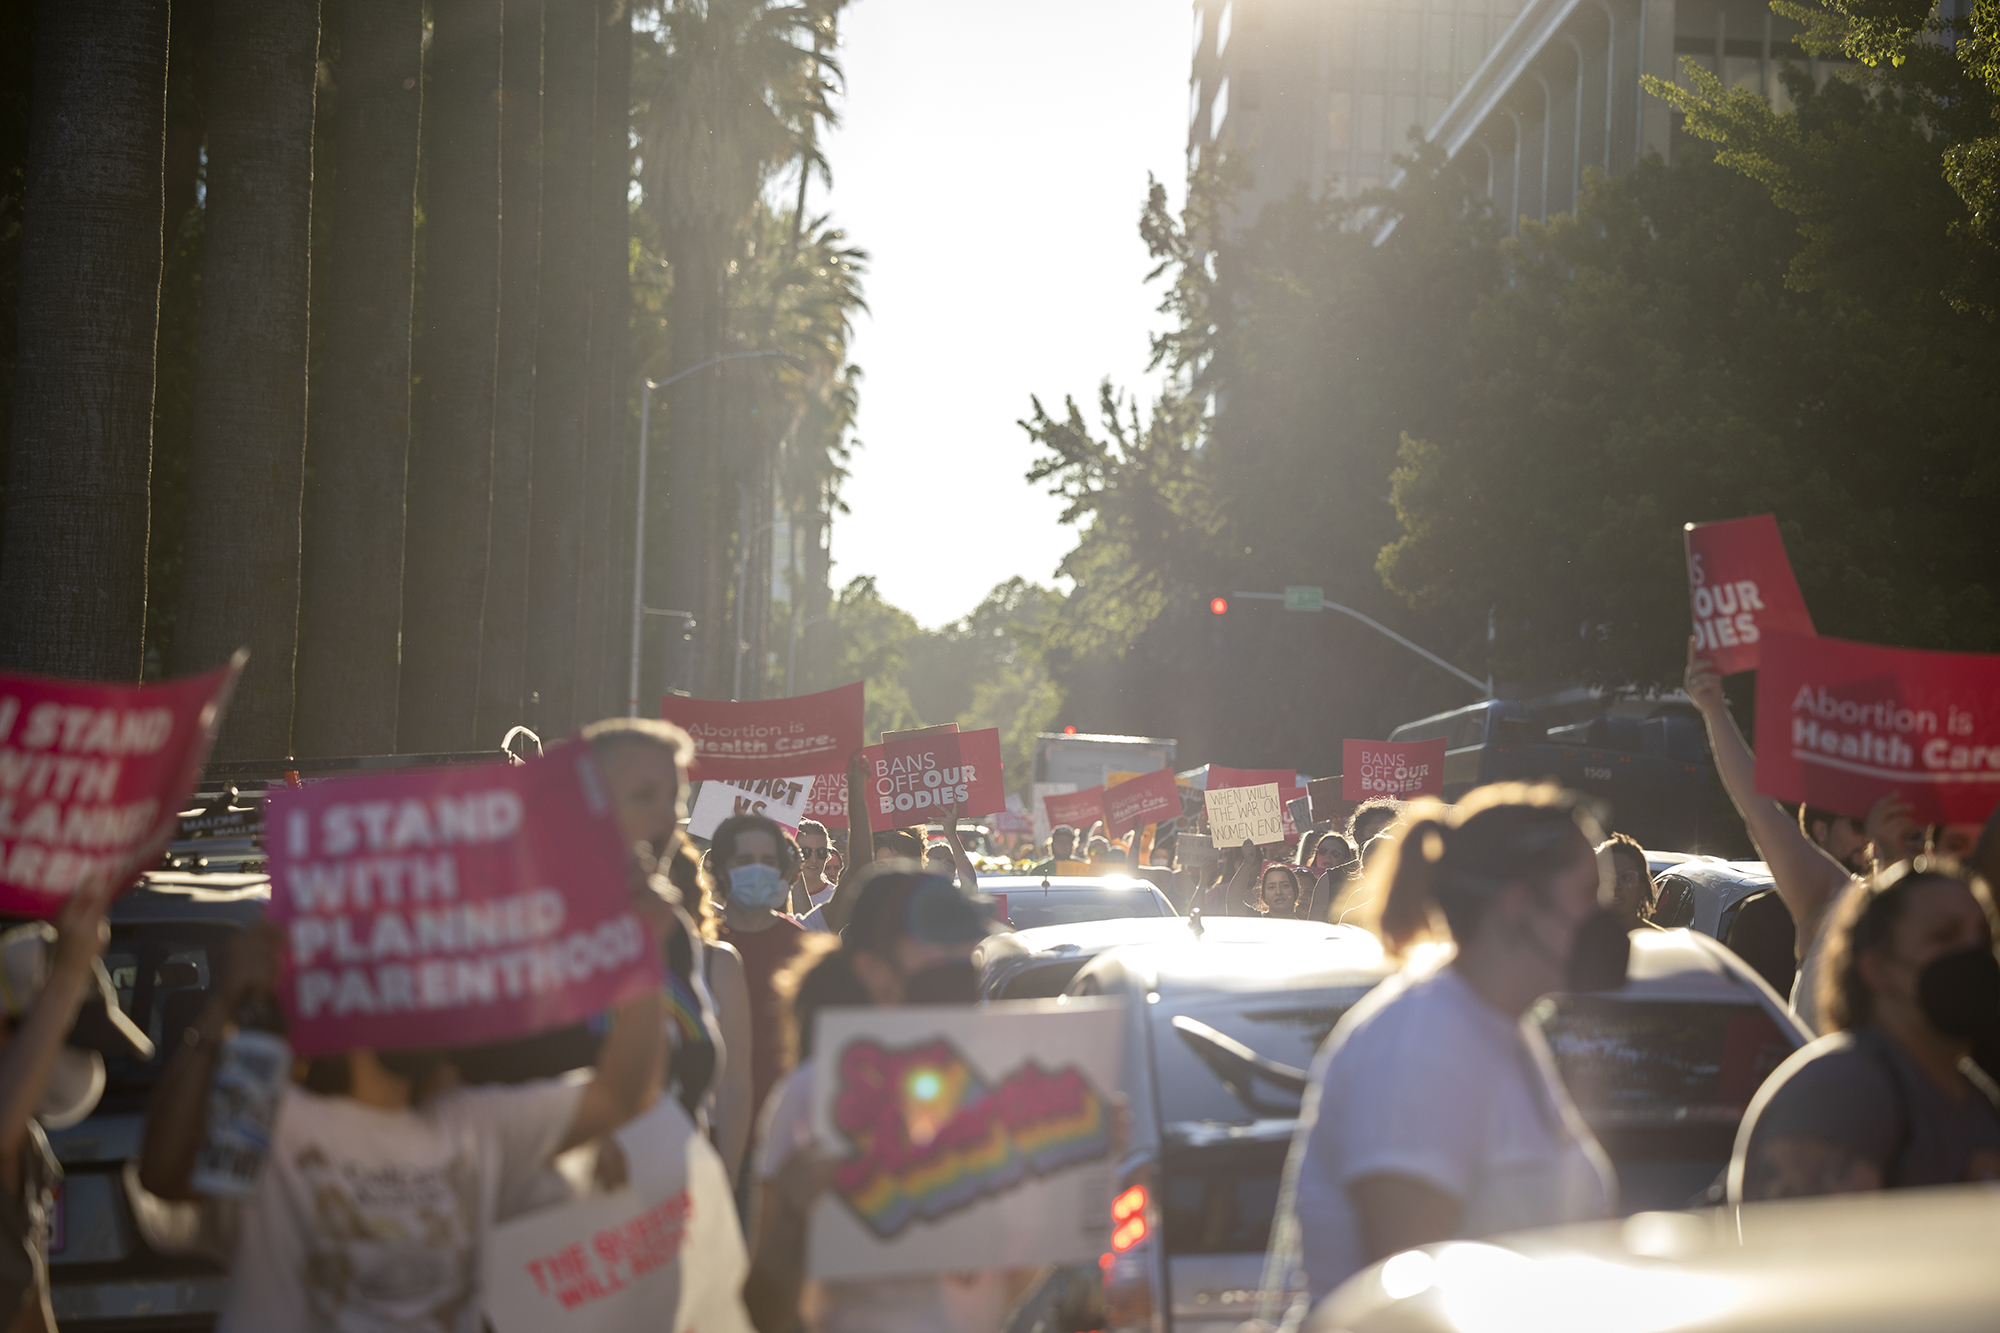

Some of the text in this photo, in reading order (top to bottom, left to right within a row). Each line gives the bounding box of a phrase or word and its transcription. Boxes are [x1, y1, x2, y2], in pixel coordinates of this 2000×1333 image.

[1695, 580, 1765, 619] OUR
[1792, 684, 1974, 736] Abortion is
[24, 702, 174, 754] STAND
[688, 720, 805, 739] Abortion is
[1792, 715, 1914, 769] Health
[876, 751, 936, 777] BANS
[1360, 763, 1430, 780] OFF OUR
[1361, 751, 1406, 767] BANS
[815, 773, 848, 787] ANS
[876, 771, 920, 795] OFF
[923, 764, 977, 789] OUR
[1361, 777, 1423, 792] BODIES
[879, 783, 970, 814] BODIES
[1209, 804, 1235, 823] THE
[1236, 800, 1261, 819] WAR
[1263, 795, 1280, 814] ON
[1210, 788, 1242, 806] WHEN
[1245, 785, 1272, 802] WILL
[286, 789, 524, 861] I STAND
[1212, 821, 1255, 841] WOMEN
[1257, 814, 1283, 837] END?
[285, 853, 460, 912] WITH
[292, 886, 566, 964] PLANNED
